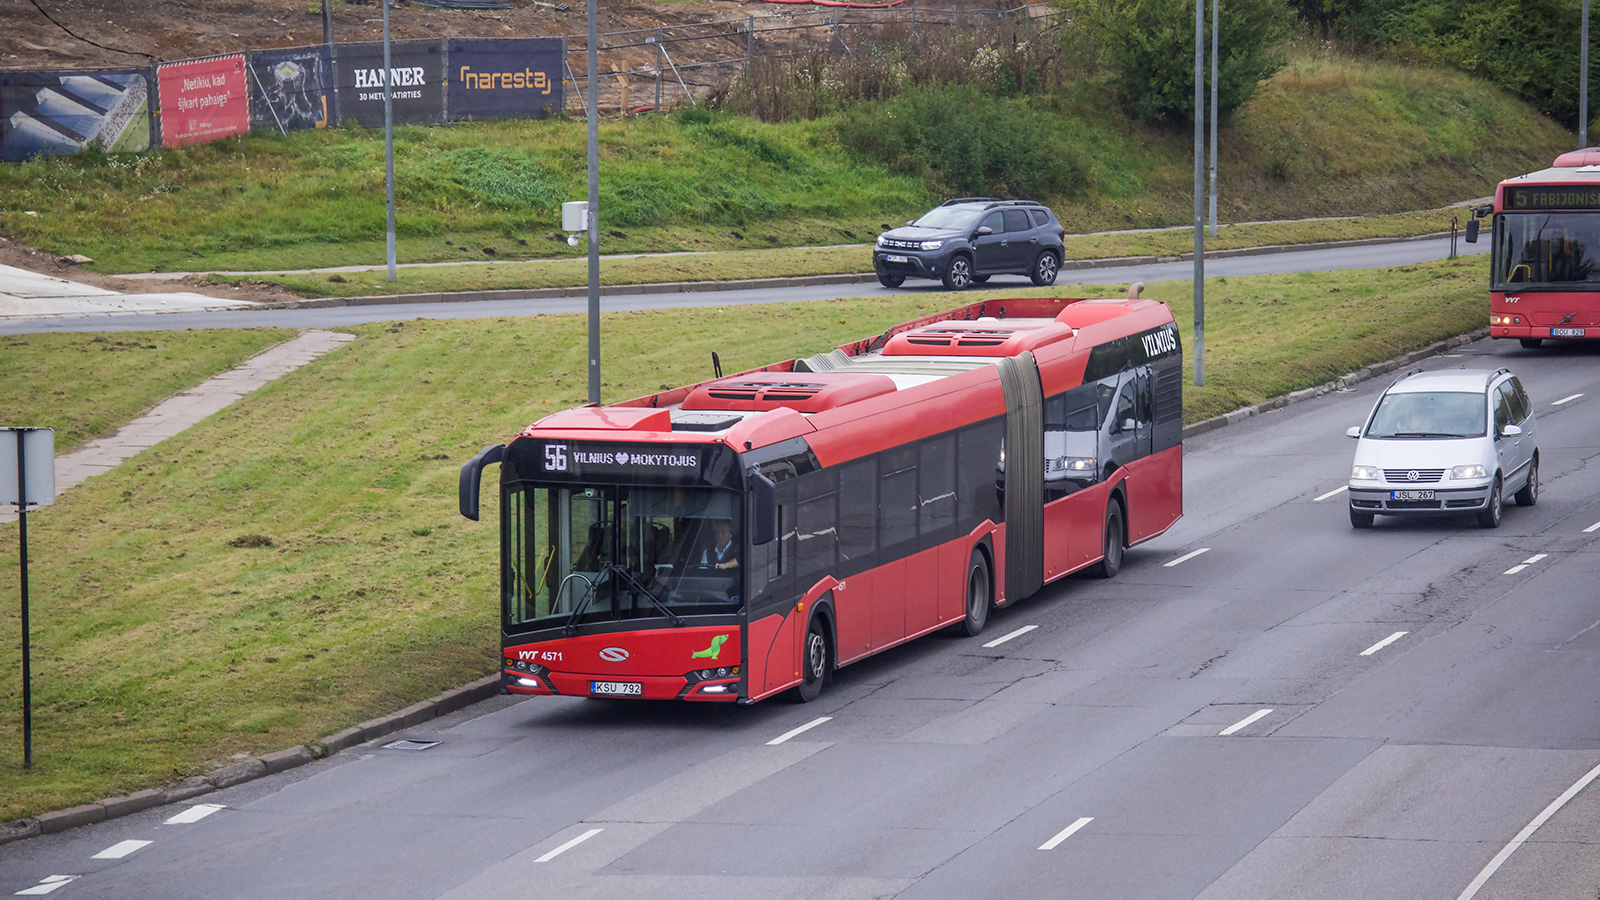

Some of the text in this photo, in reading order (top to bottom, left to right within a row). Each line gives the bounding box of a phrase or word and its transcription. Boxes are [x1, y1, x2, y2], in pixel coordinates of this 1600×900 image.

[212, 73, 226, 86] kad
[354, 66, 426, 88] HANNER
[464, 67, 547, 91] naresta
[359, 92, 368, 101] 30
[1516, 190, 1600, 207] 5 FABIJONIŠ
[1141, 328, 1177, 358] VILNIUS
[544, 444, 697, 471] 56 VILNIUS MOKYTOJUS
[1396, 491, 1433, 499] JSL 267
[518, 650, 563, 661] VVT 4571
[596, 683, 640, 694] KSU 792
